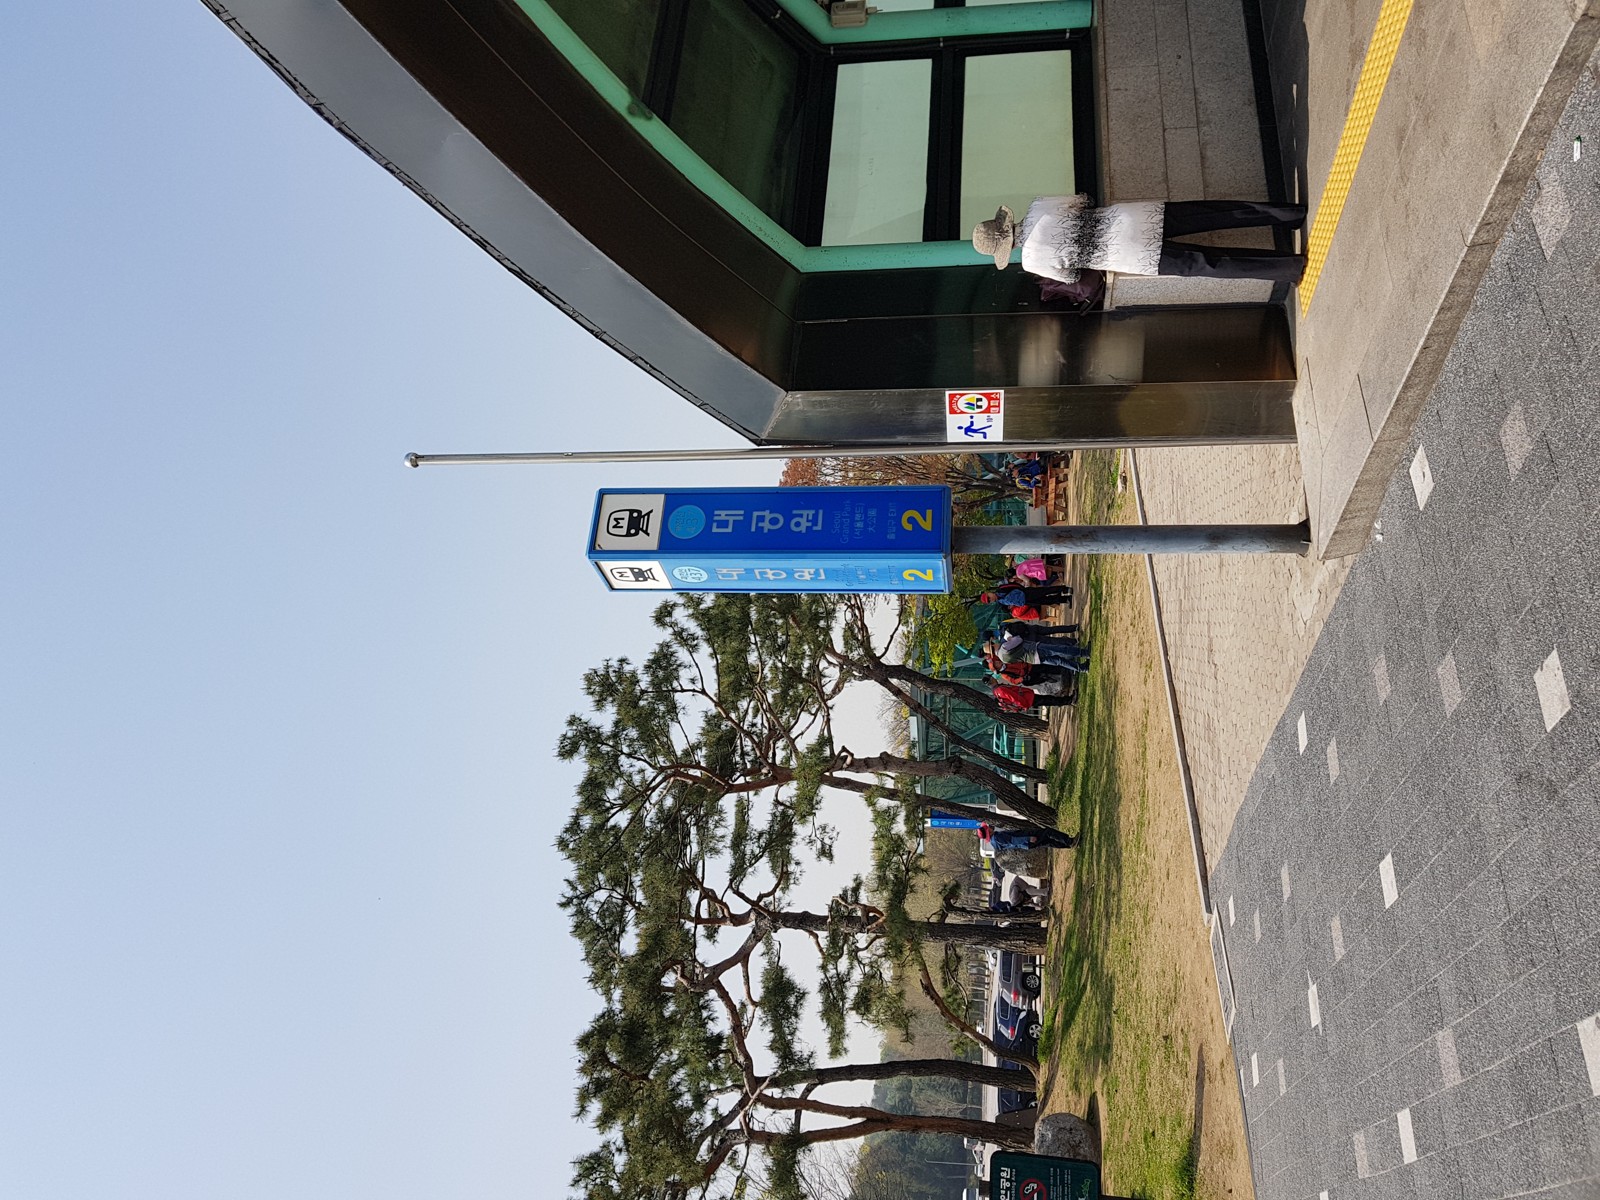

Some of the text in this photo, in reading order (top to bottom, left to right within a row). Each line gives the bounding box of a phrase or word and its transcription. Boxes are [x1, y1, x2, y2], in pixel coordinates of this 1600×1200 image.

[712, 509, 823, 533] 대공원
[831, 510, 840, 534] Seoul
[840, 499, 851, 543] Grand Park
[901, 509, 932, 531] 2
[714, 568, 826, 580] 대공원
[902, 569, 933, 581] 2
